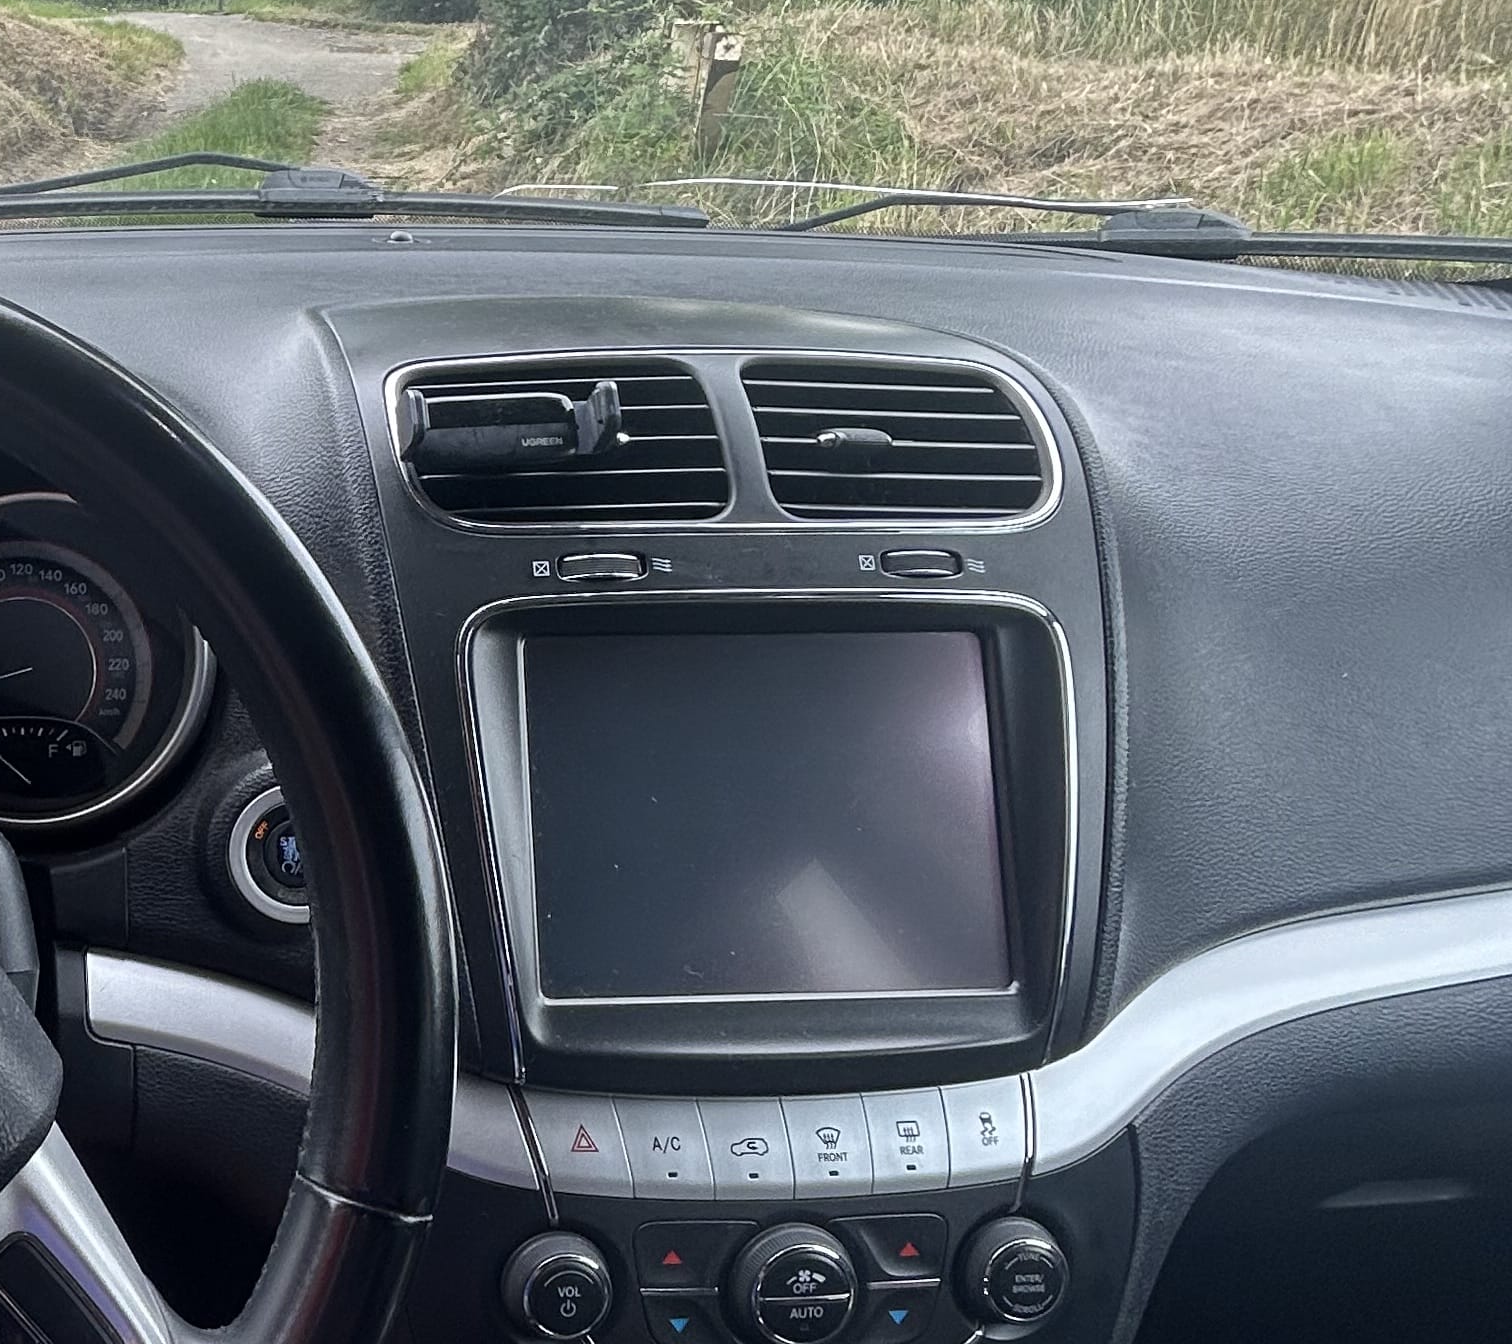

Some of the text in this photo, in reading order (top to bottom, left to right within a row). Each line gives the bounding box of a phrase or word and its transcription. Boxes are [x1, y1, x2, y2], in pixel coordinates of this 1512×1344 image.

[521, 437, 563, 447] UGREEN
[10, 563, 33, 576] 120
[39, 569, 63, 582] 140
[64, 582, 88, 595] 160
[85, 602, 109, 616] 180
[103, 630, 124, 642] 200
[108, 658, 130, 671] 220
[105, 688, 127, 701] 240
[48, 744, 59, 757] F
[652, 1136, 681, 1154] A/C
[981, 1136, 999, 1146] OFF
[899, 1145, 924, 1155] REAR
[817, 1152, 849, 1163] FRONT
[557, 1286, 581, 1298] VOL
[792, 1281, 819, 1295] OFF
[789, 1306, 825, 1320] AUTO
